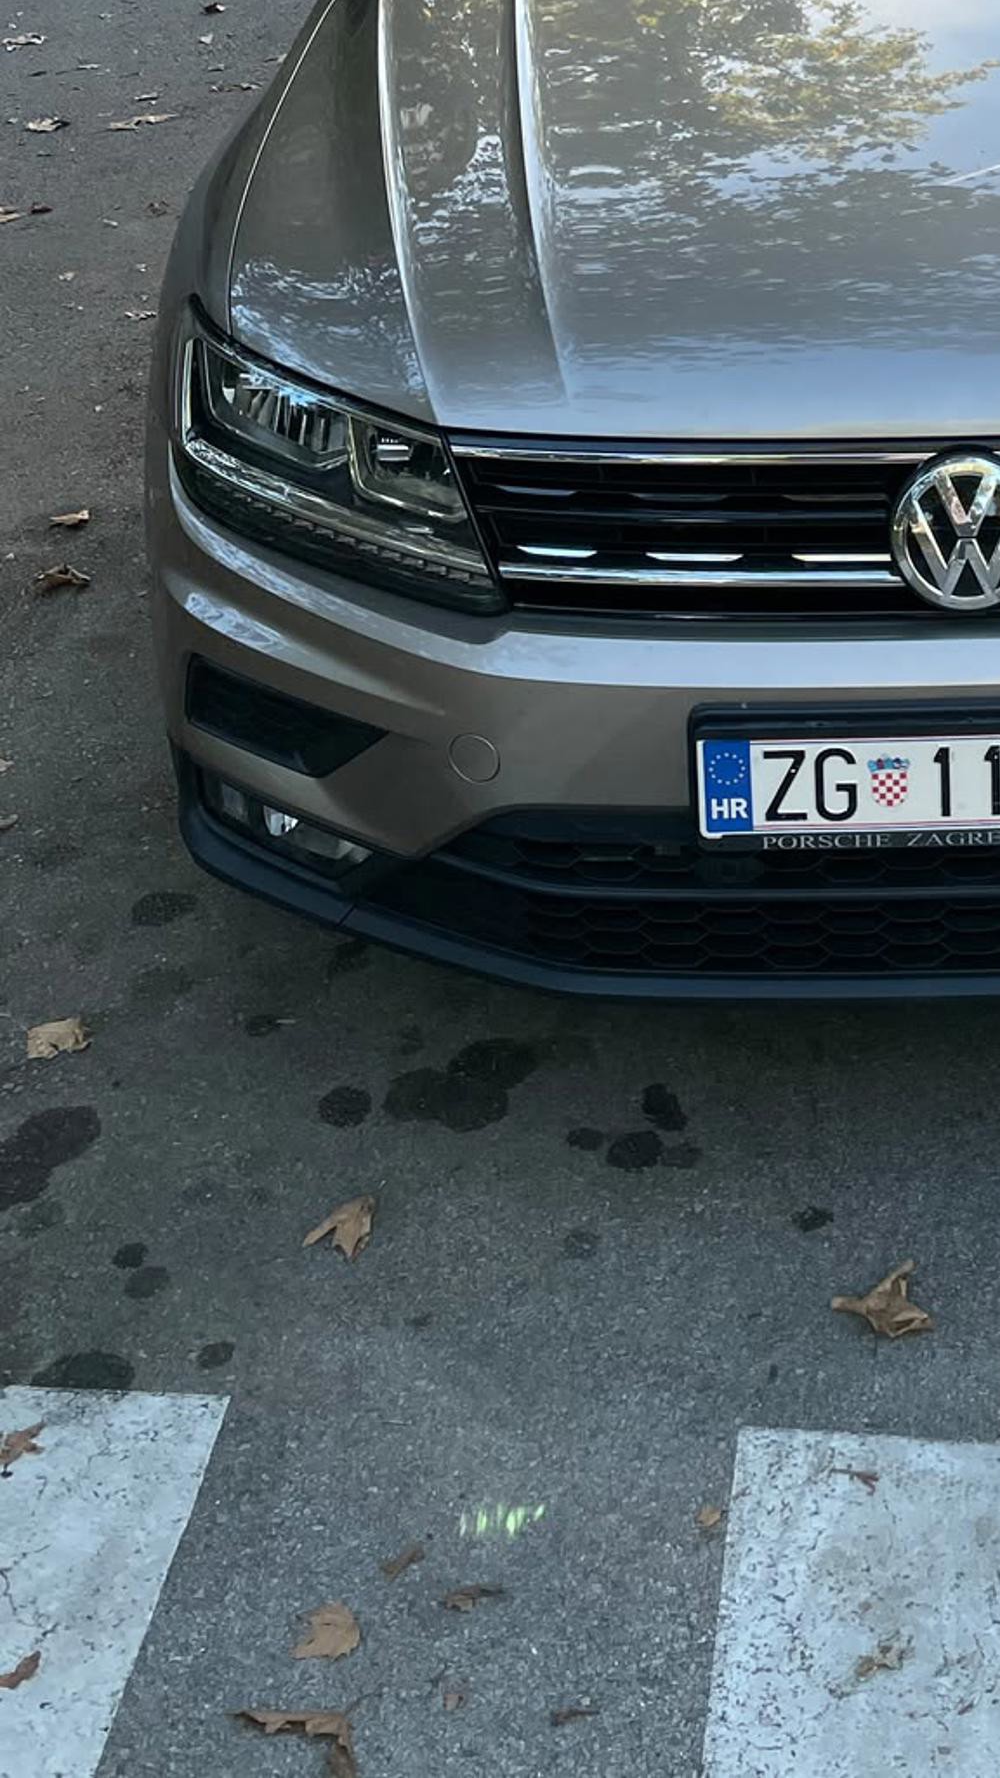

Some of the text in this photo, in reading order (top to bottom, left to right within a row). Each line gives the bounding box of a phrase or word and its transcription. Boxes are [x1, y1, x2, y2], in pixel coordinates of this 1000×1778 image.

[763, 747, 858, 822] ZG
[711, 798, 749, 820] HR
[762, 833, 890, 850] PORSCHE
